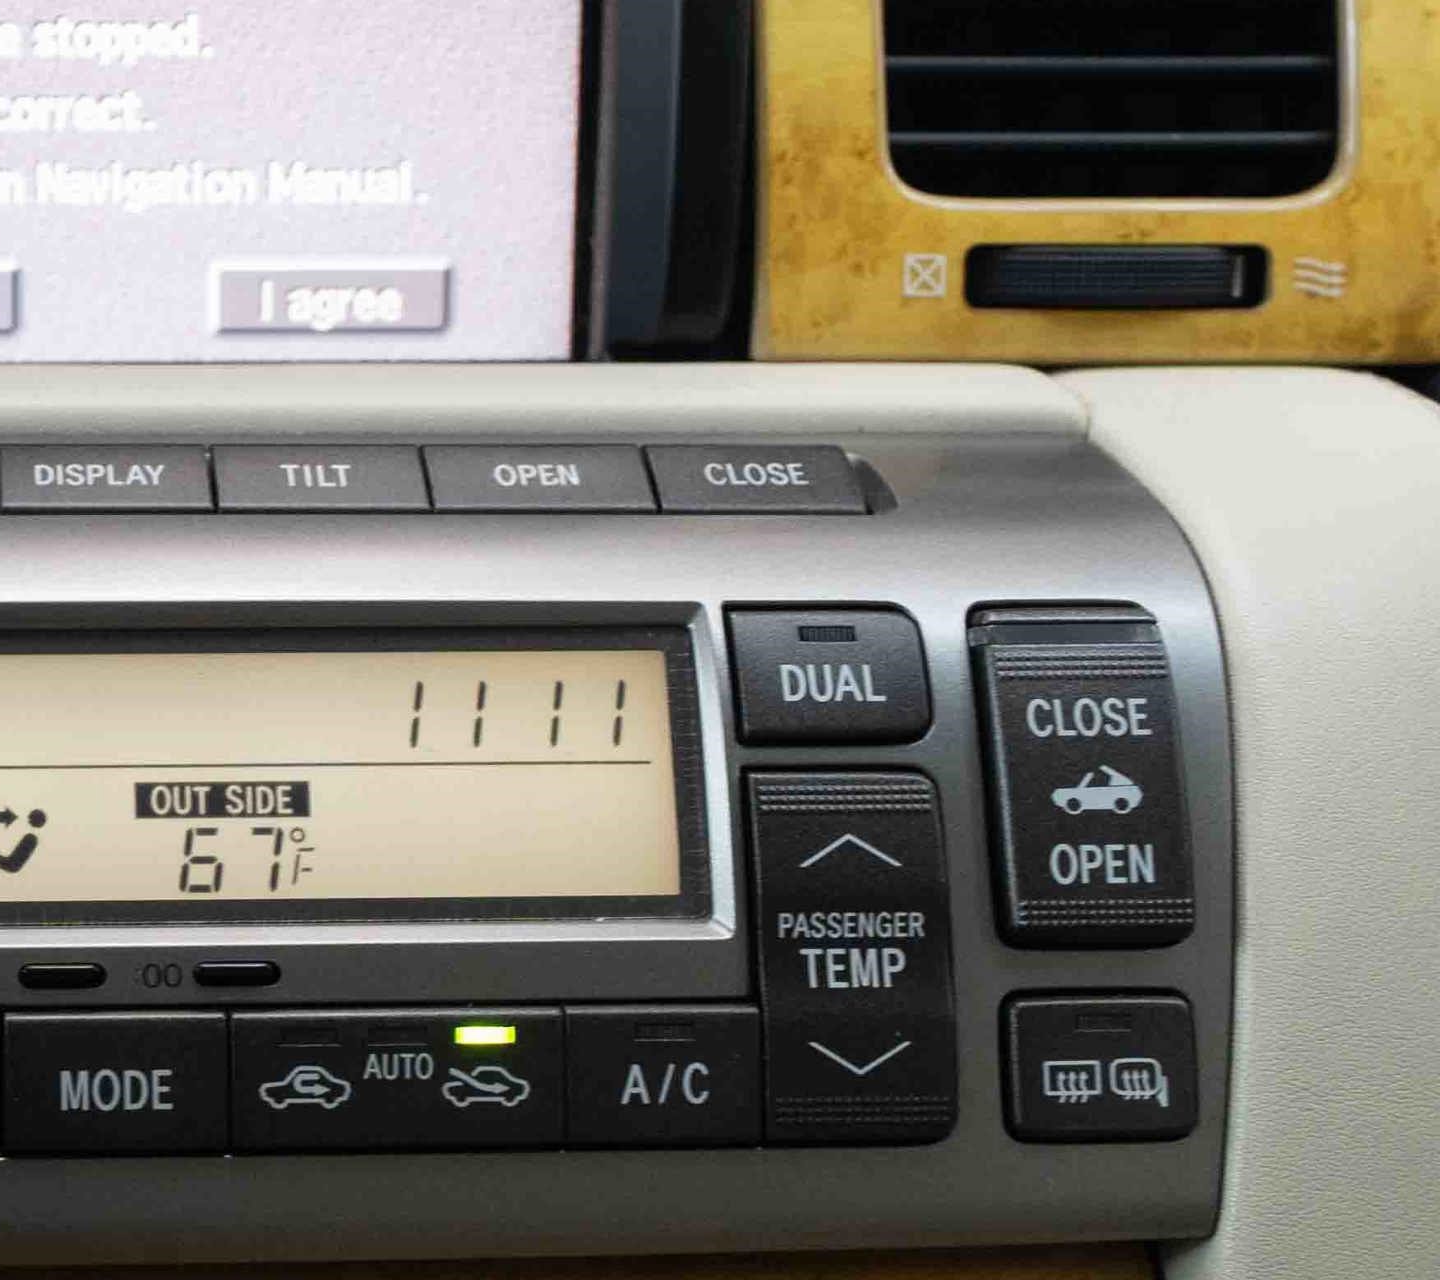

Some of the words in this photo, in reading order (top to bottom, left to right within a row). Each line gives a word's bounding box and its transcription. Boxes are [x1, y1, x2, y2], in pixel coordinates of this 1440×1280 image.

[32, 13, 215, 66] stopped.
[36, 161, 259, 213] Navigation
[267, 161, 431, 205] Manual.
[261, 280, 274, 321] I
[287, 287, 404, 331] agree
[33, 463, 166, 487] DISPLAY
[280, 463, 351, 487] TILT
[493, 463, 580, 487] OPEN
[703, 462, 809, 487] CLOSE
[780, 664, 886, 702] DUAL
[1027, 697, 1152, 737] CLOSE
[151, 786, 210, 815] OUT
[226, 787, 294, 815] SIDE
[1050, 844, 1155, 884] OPEN
[777, 912, 925, 938] PASSENGER
[800, 948, 906, 988] TEMP
[363, 1053, 434, 1080] AUTO
[621, 1062, 709, 1105] A/C
[59, 1069, 173, 1111] MODE
